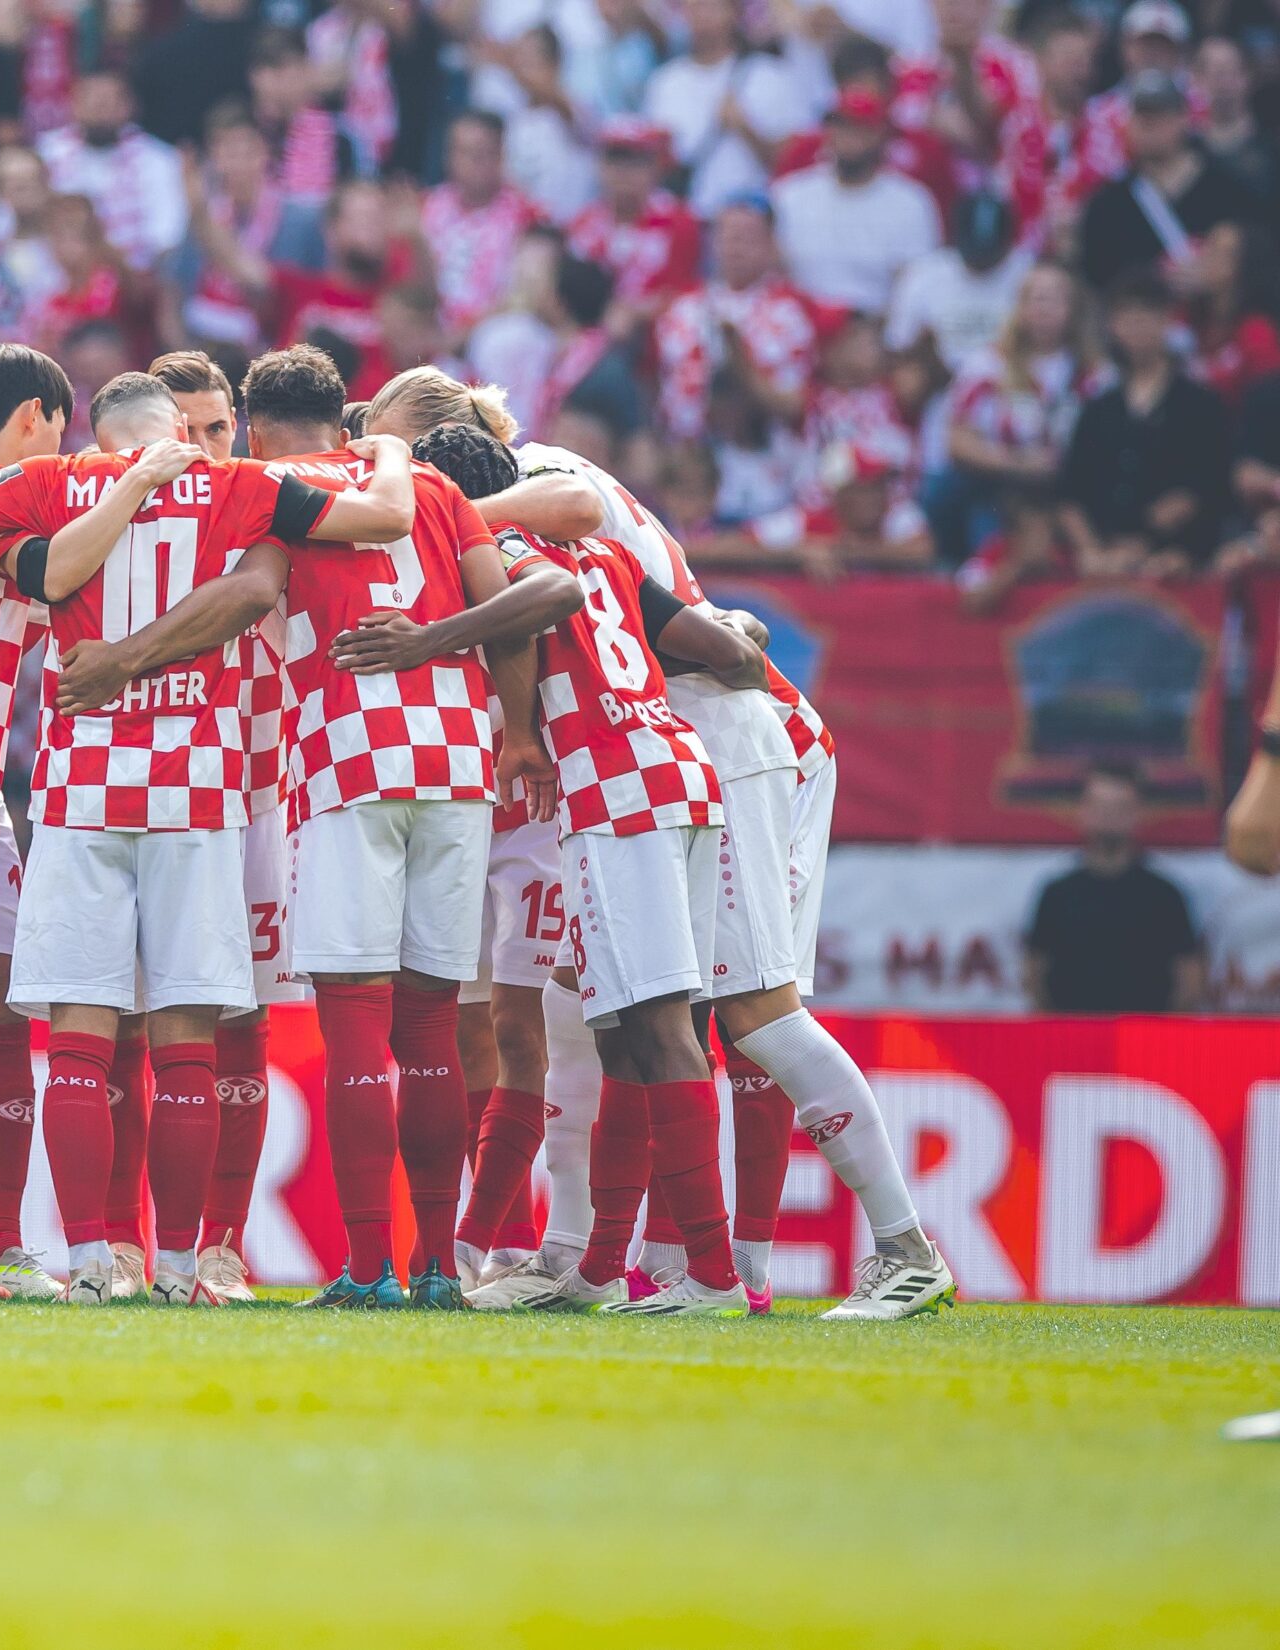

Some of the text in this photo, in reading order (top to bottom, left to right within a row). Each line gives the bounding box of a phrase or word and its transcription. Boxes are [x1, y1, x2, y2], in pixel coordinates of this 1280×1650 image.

[66, 473, 212, 513] MAZ 05
[576, 566, 650, 692] 8
[250, 901, 288, 962] 3
[568, 913, 588, 977] 8
[533, 953, 556, 968] JAK
[581, 986, 597, 1003] AKO
[343, 1072, 390, 1087] JAK
[399, 1066, 450, 1078] JAKO
